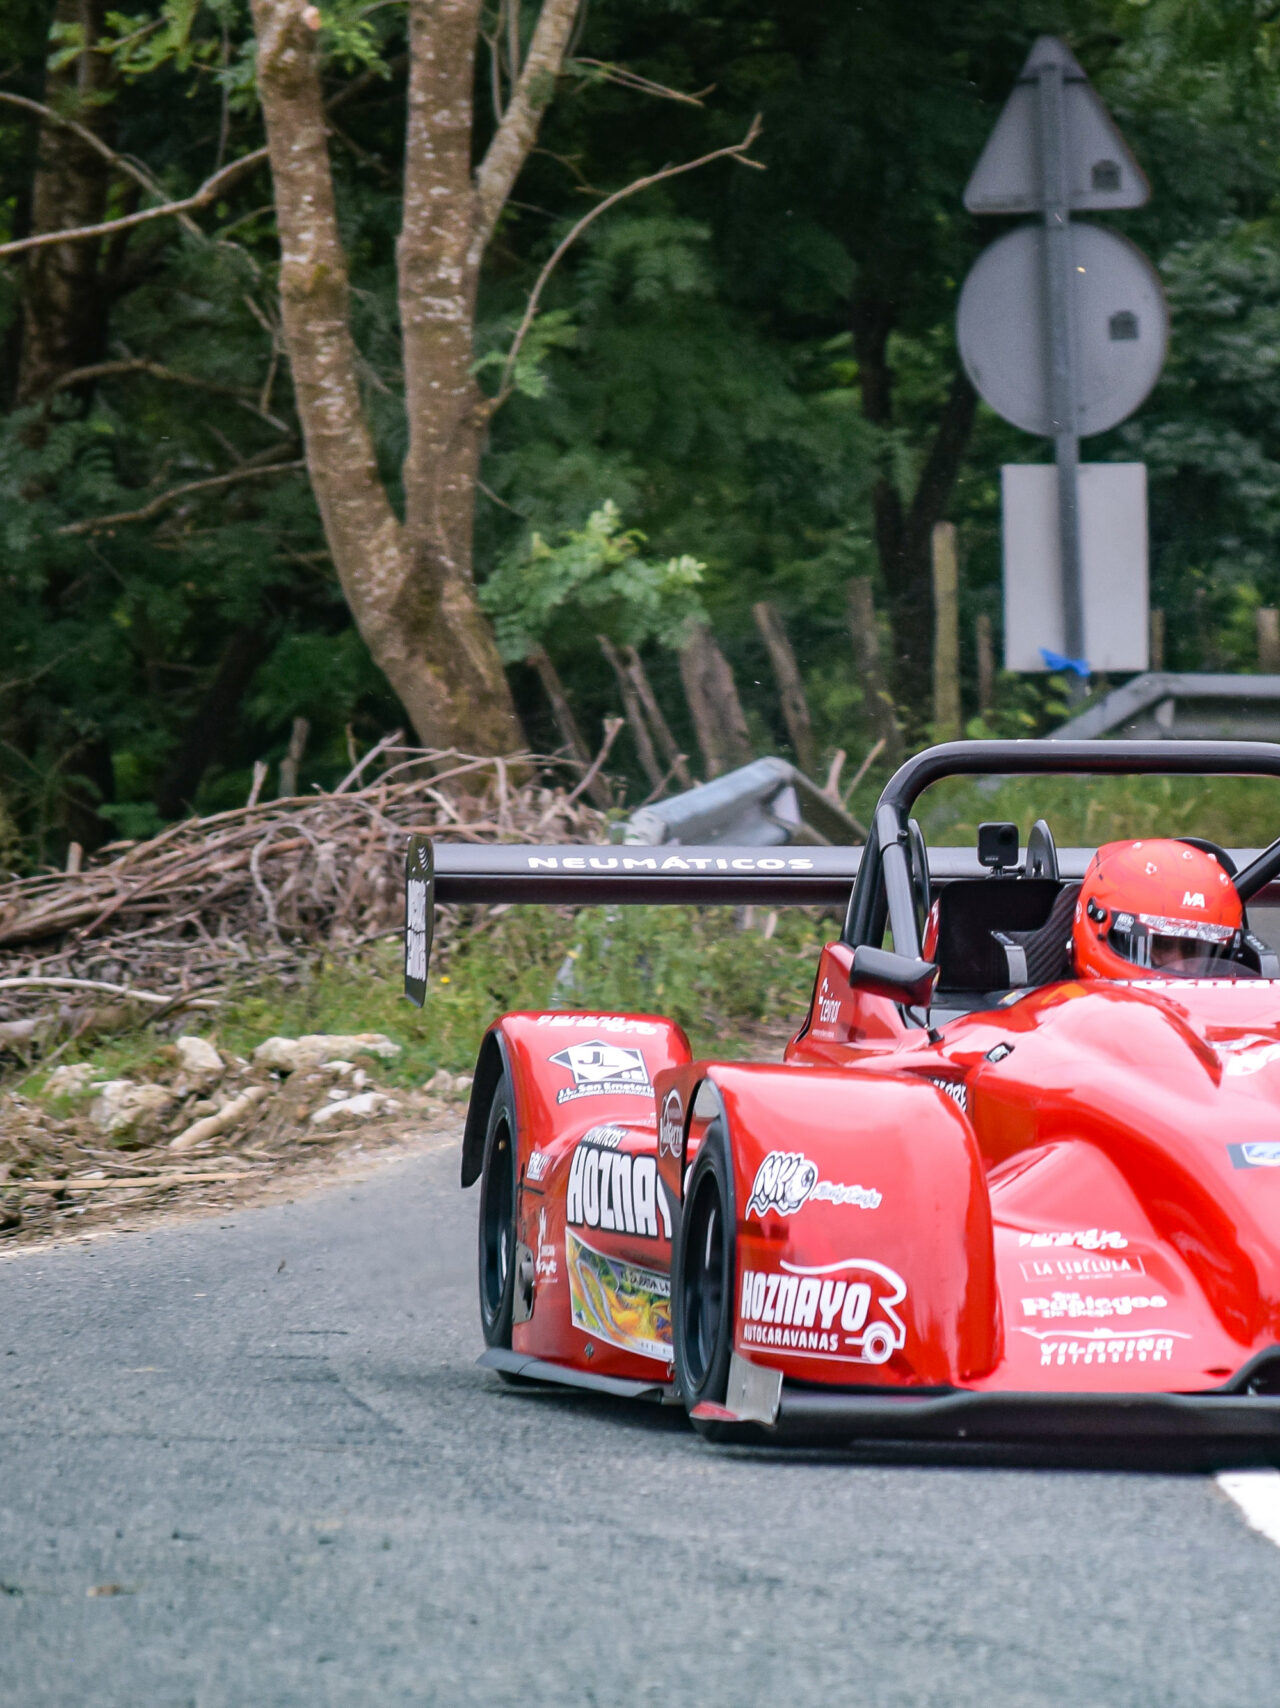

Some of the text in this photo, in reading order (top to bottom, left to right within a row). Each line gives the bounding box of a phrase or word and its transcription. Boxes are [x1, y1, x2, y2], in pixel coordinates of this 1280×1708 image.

[527, 855, 814, 870] NEUMÁTICOS
[740, 1270, 872, 1331] HOZNAYO
[743, 1324, 839, 1351] AUTOCARAVANAS
